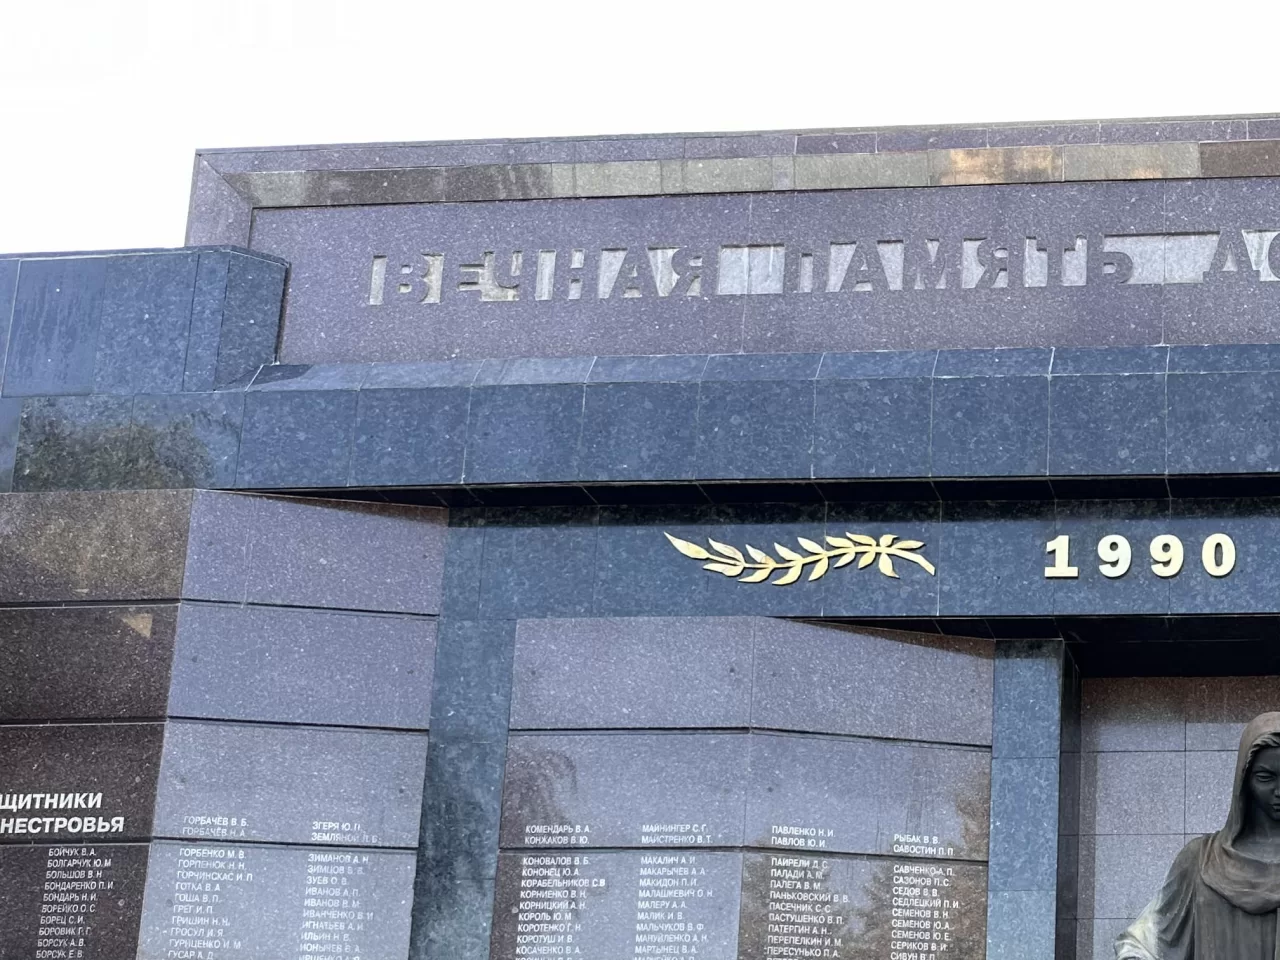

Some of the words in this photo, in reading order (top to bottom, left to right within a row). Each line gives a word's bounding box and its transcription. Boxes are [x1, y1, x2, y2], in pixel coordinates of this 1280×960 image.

[1044, 533, 1235, 577] 1990
[0, 816, 125, 834] НЕСТРОВЬЯ
[48, 847, 79, 857] БОЙЧУК
[46, 870, 85, 879] БОЛЬШОВ
[44, 881, 96, 891] БОНДАРЕНКО
[43, 892, 79, 902] БОНДАРЬ
[40, 915, 67, 925] БОРЕЦ
